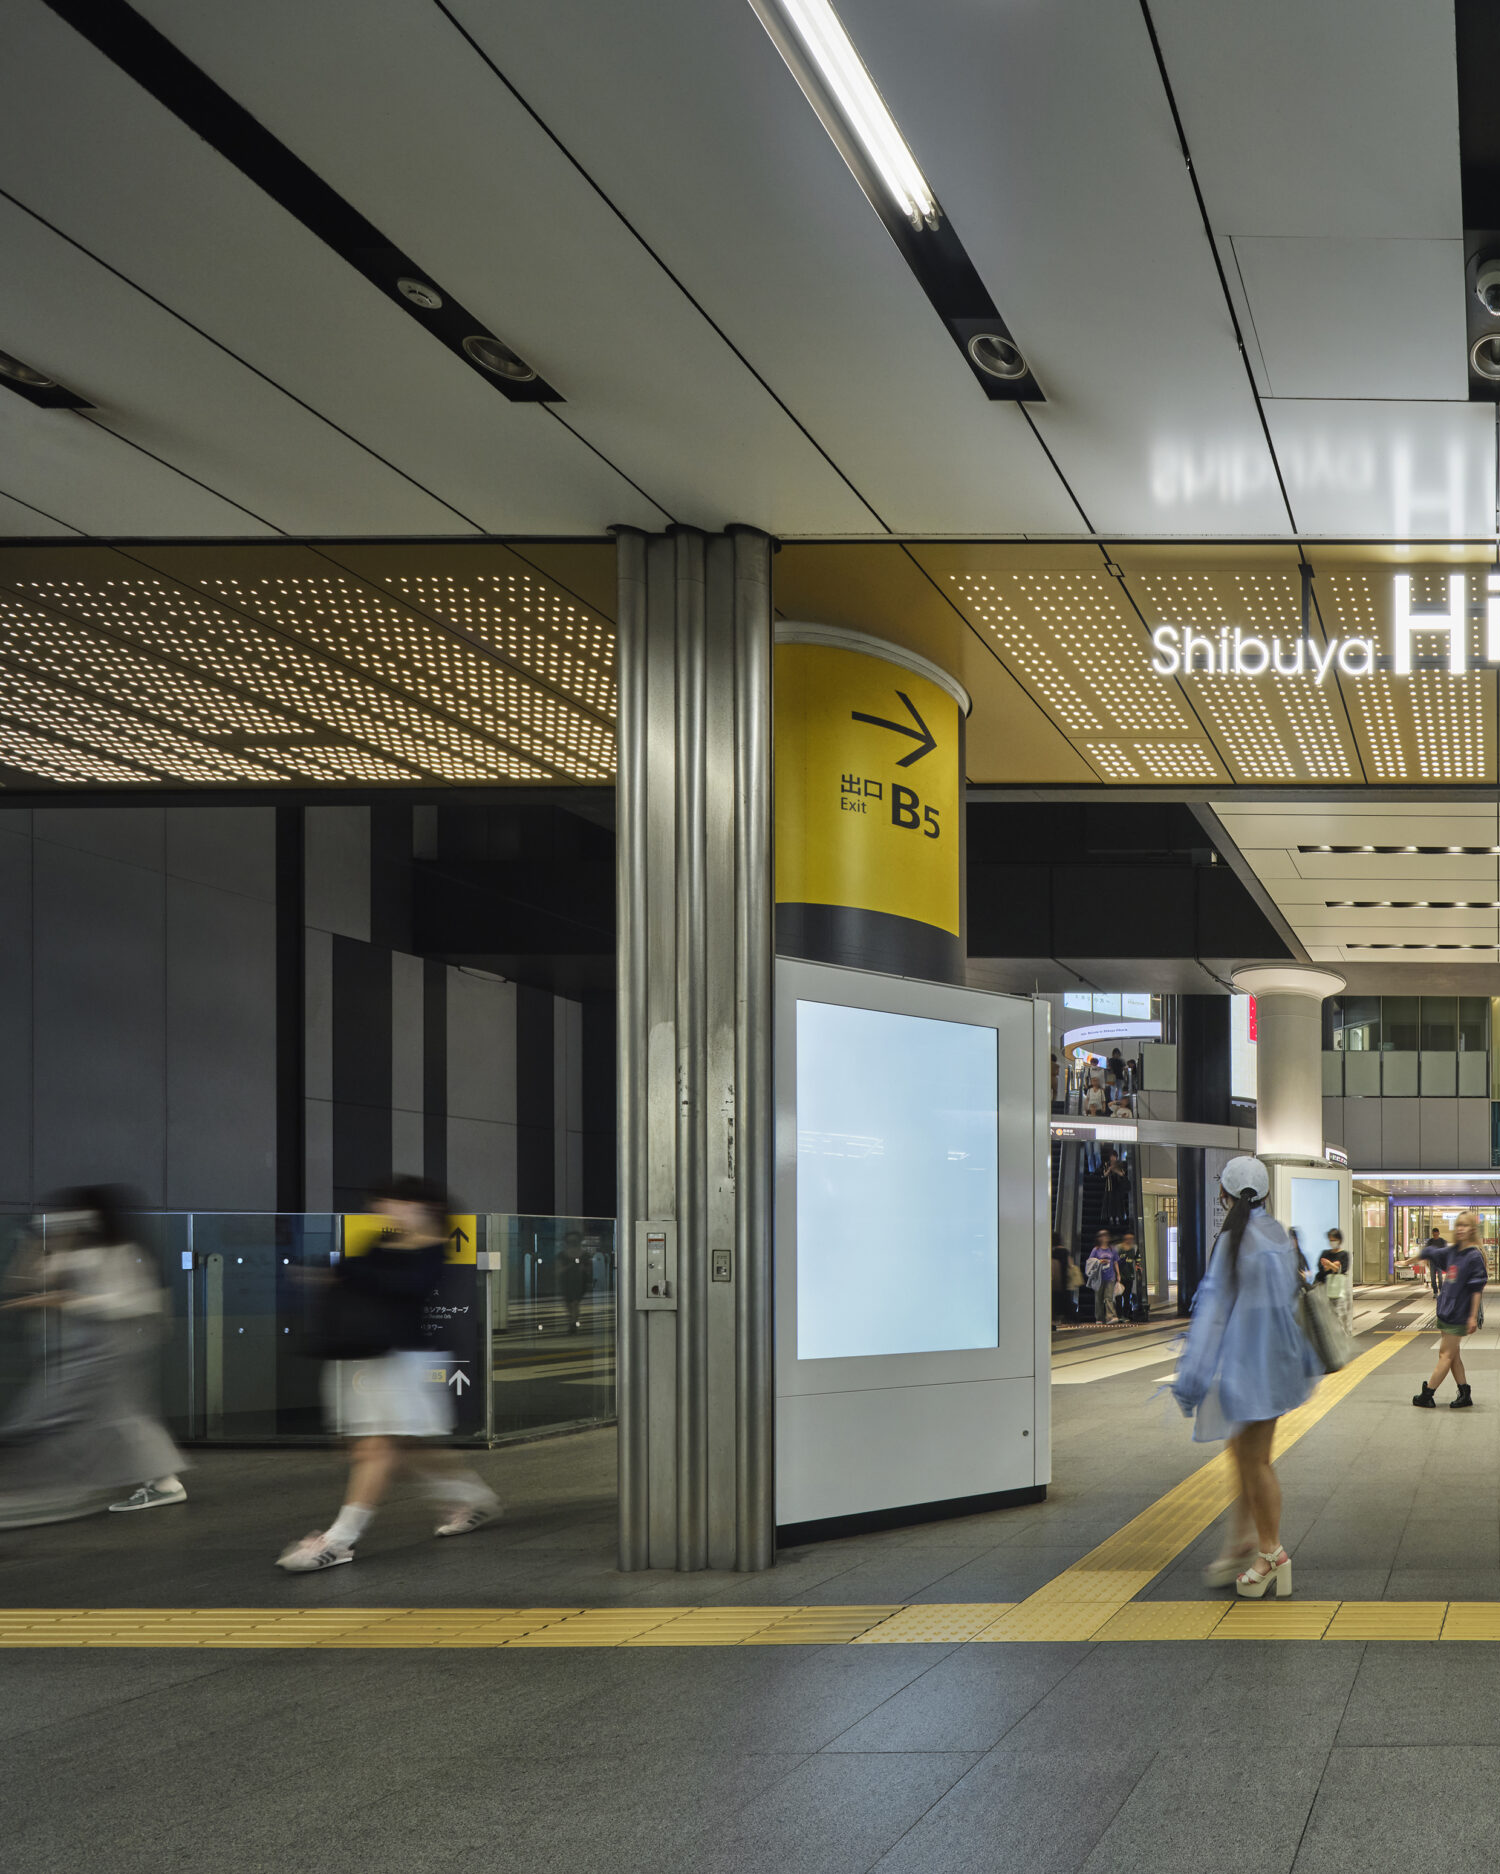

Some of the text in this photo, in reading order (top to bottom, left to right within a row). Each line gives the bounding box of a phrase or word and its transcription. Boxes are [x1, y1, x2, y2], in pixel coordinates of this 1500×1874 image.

[1152, 625, 1375, 685] Shibuya
[840, 796, 867, 814] Exit
[840, 773, 940, 839] 出口 B5
